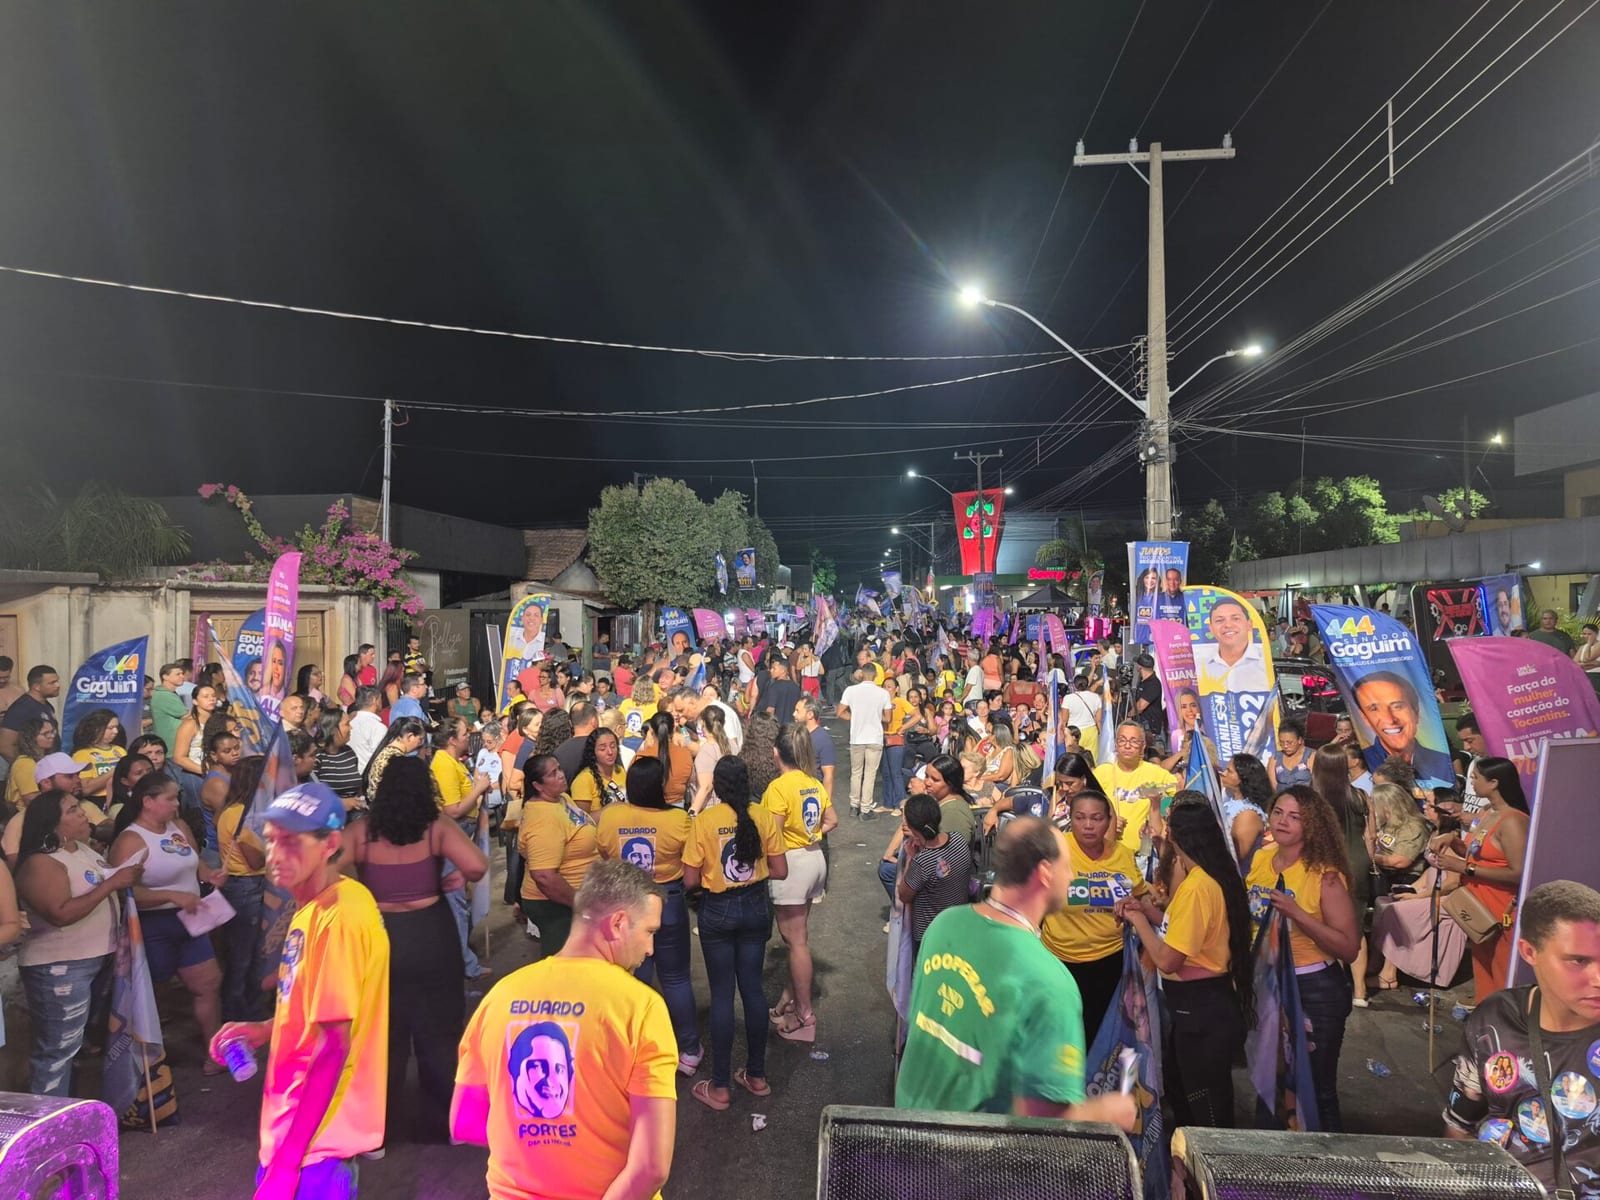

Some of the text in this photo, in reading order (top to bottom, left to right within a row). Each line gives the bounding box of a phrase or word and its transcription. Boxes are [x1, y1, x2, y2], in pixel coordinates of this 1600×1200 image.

[1325, 615, 1376, 639] 444
[1343, 632, 1409, 644] SENADOR
[1329, 637, 1411, 660] Gaguim
[1506, 676, 1557, 695] Força da
[1513, 688, 1557, 706] mulher,
[1506, 697, 1570, 718] coração do
[1511, 709, 1571, 729] Tocantins.
[509, 999, 586, 1017] EDUARDO
[518, 1123, 577, 1139] FORTES
